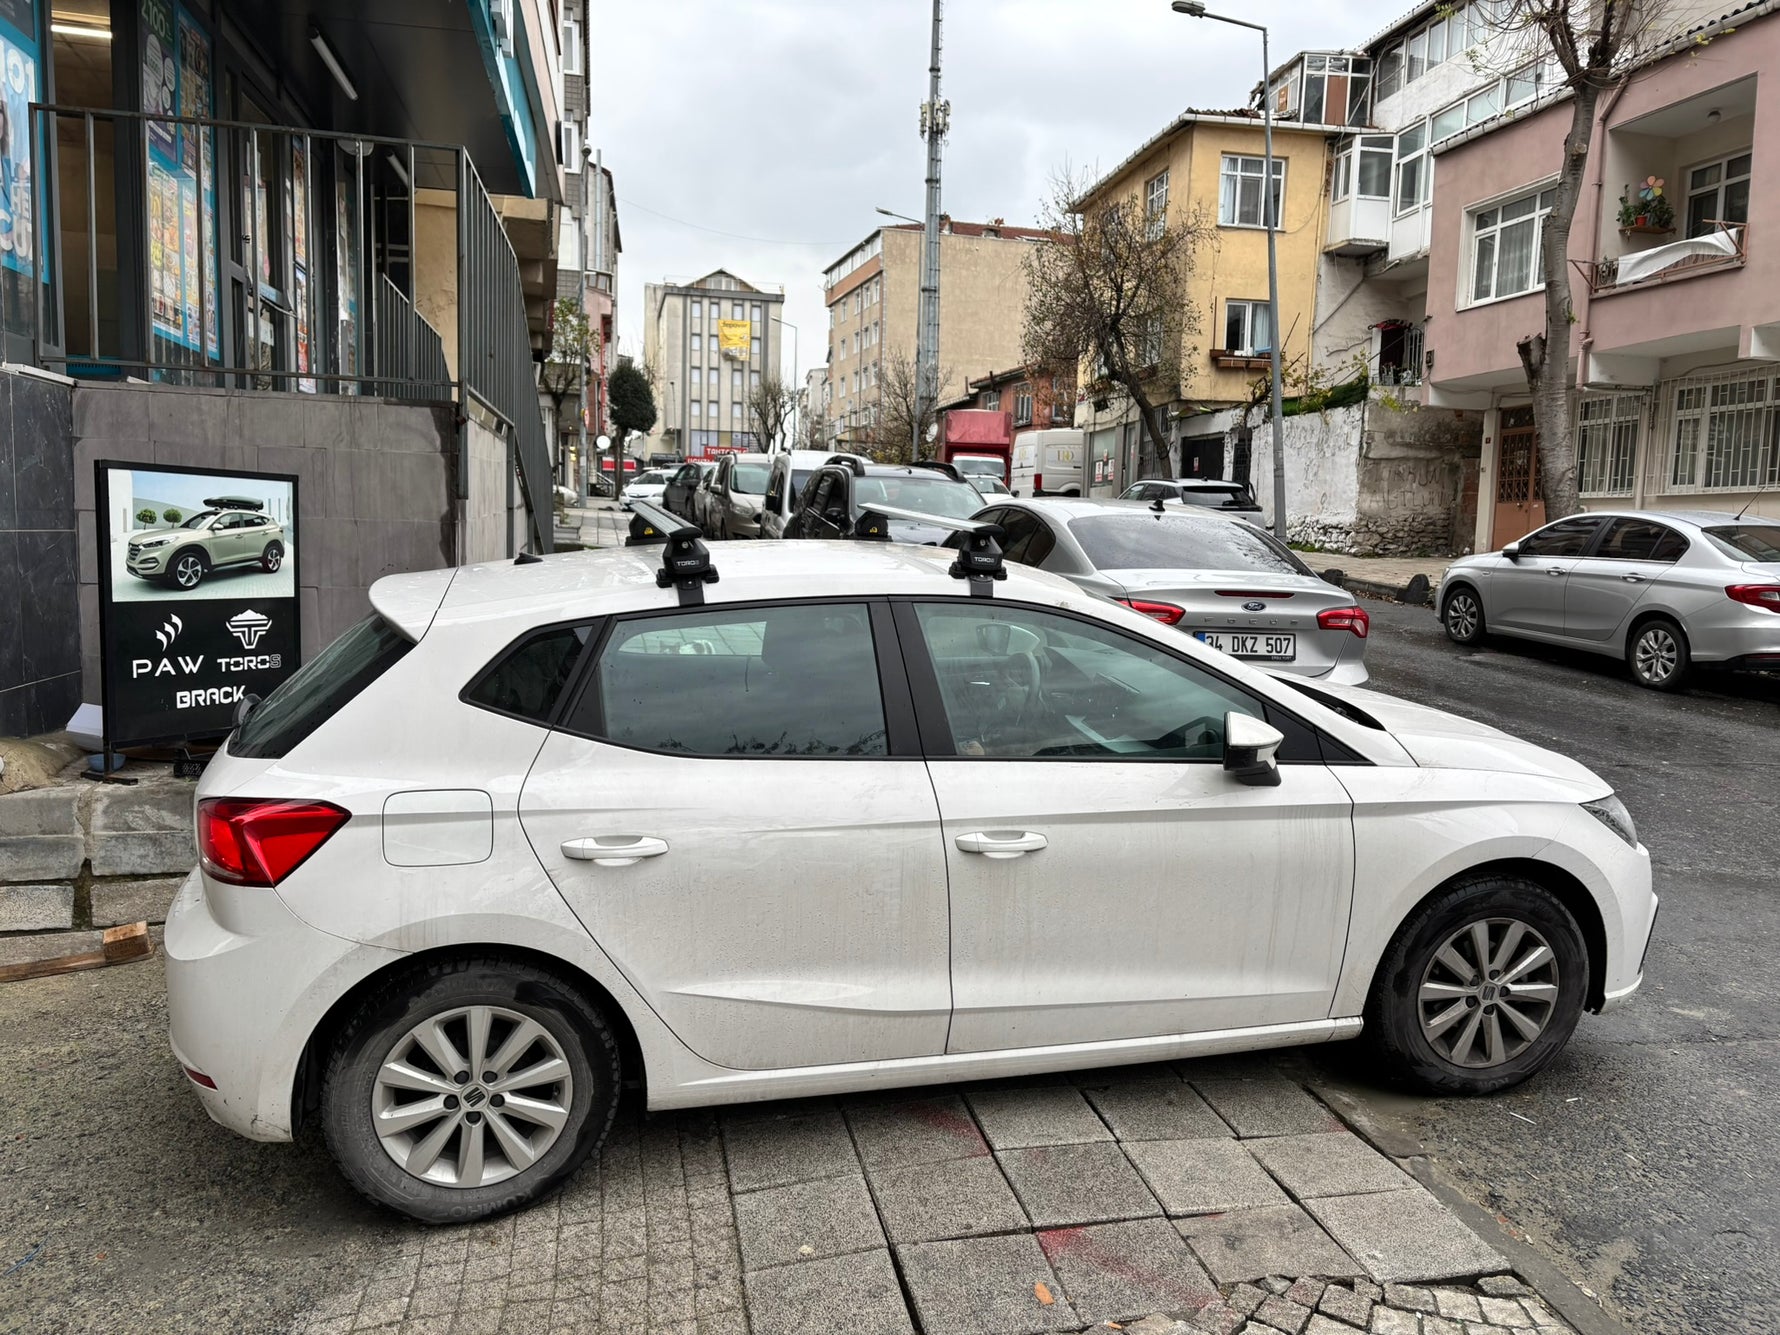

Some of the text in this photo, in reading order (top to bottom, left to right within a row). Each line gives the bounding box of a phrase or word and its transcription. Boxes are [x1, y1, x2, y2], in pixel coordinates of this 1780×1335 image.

[1231, 636, 1258, 653] DKZ
[1265, 637, 1291, 654] 507
[131, 653, 282, 678] PAW TOROS
[176, 685, 246, 709] BRACK
